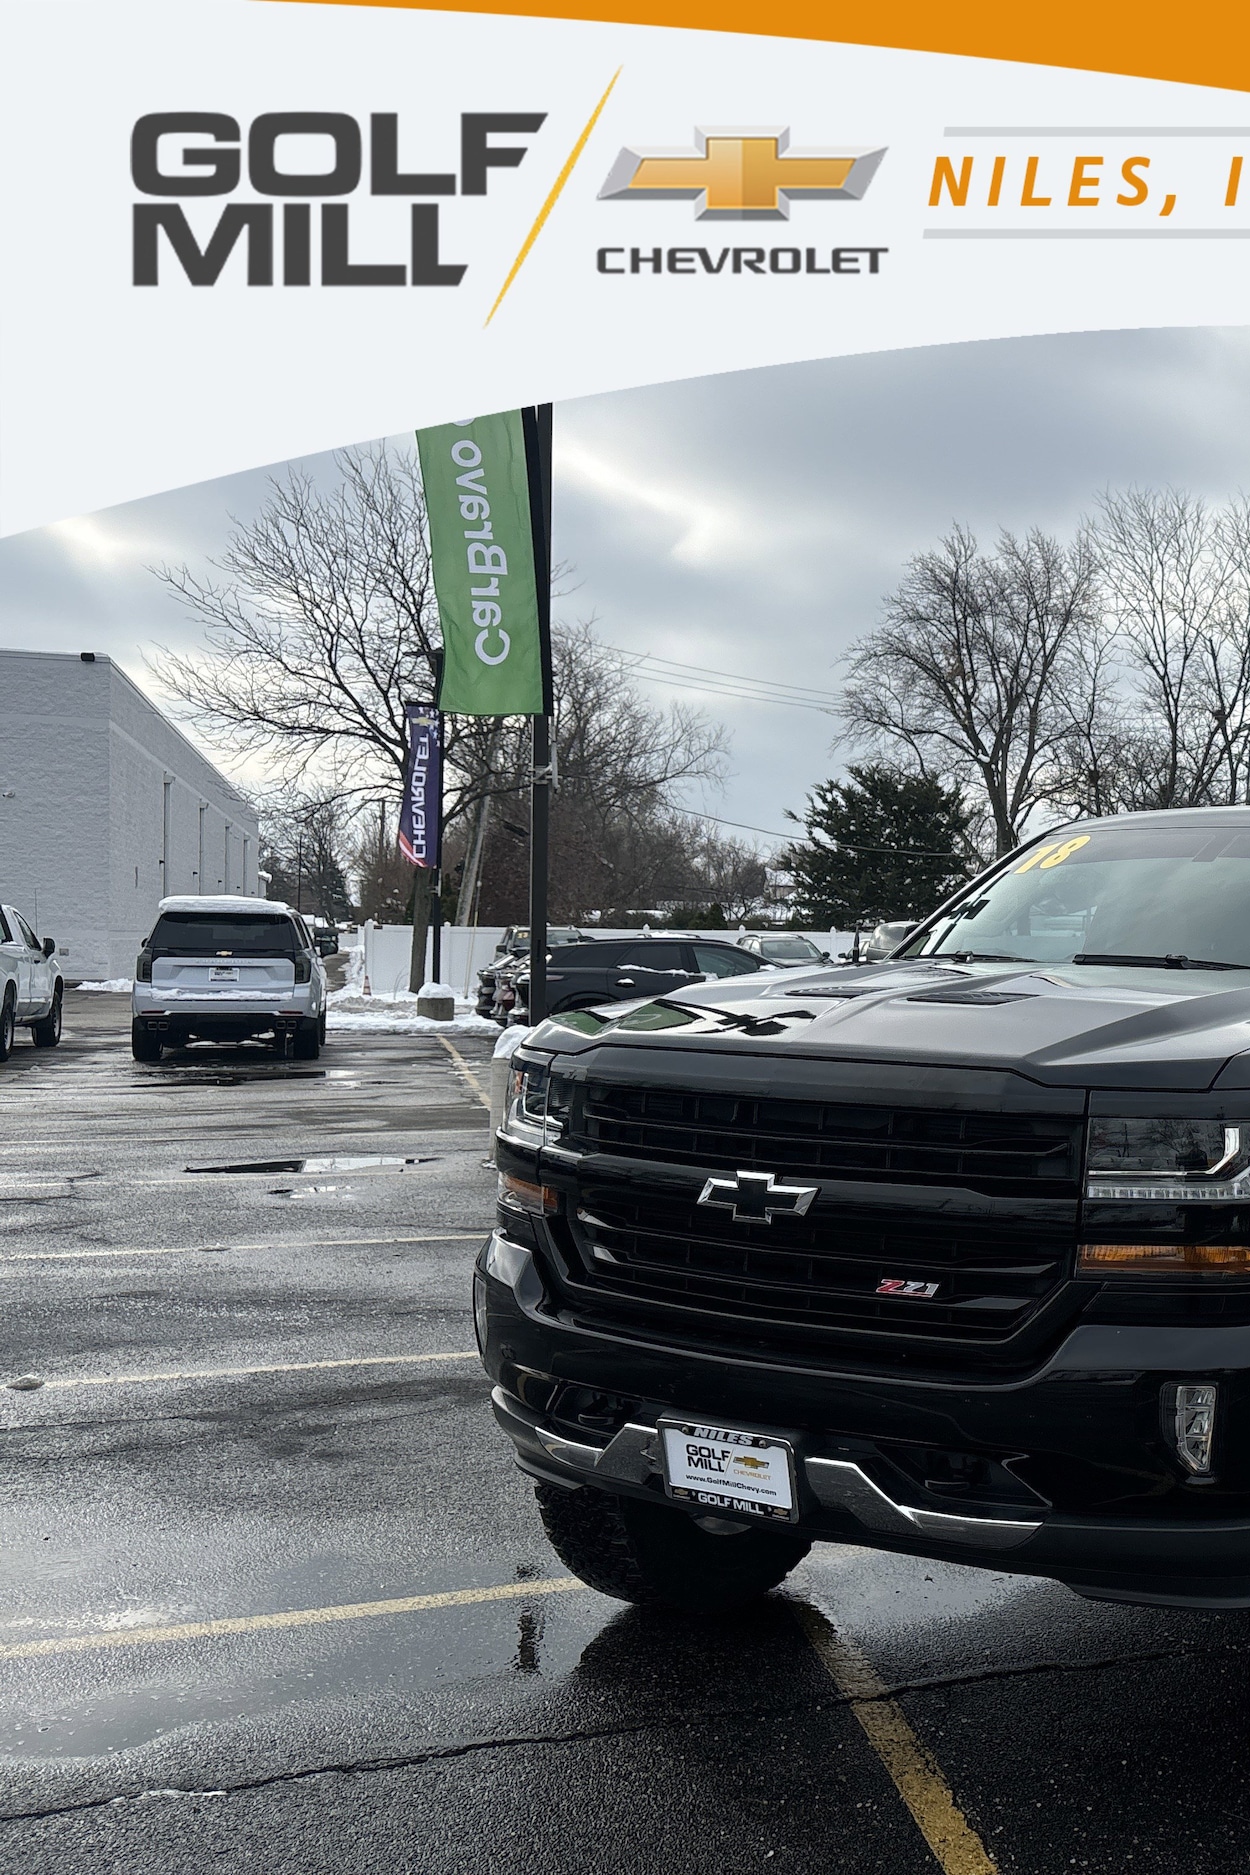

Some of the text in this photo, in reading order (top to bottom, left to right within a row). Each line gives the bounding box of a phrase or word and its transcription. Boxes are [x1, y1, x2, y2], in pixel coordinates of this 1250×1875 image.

[1014, 835, 1091, 875] 18
[876, 1278, 940, 1298] Z71
[693, 1427, 754, 1446] NILES
[686, 1443, 731, 1461] GOLF
[687, 1456, 725, 1473] MILL
[685, 1473, 777, 1496] www.GolfMillChevy.com
[733, 1469, 772, 1481] CHEVROLET
[697, 1492, 765, 1516] GOLF MILL
